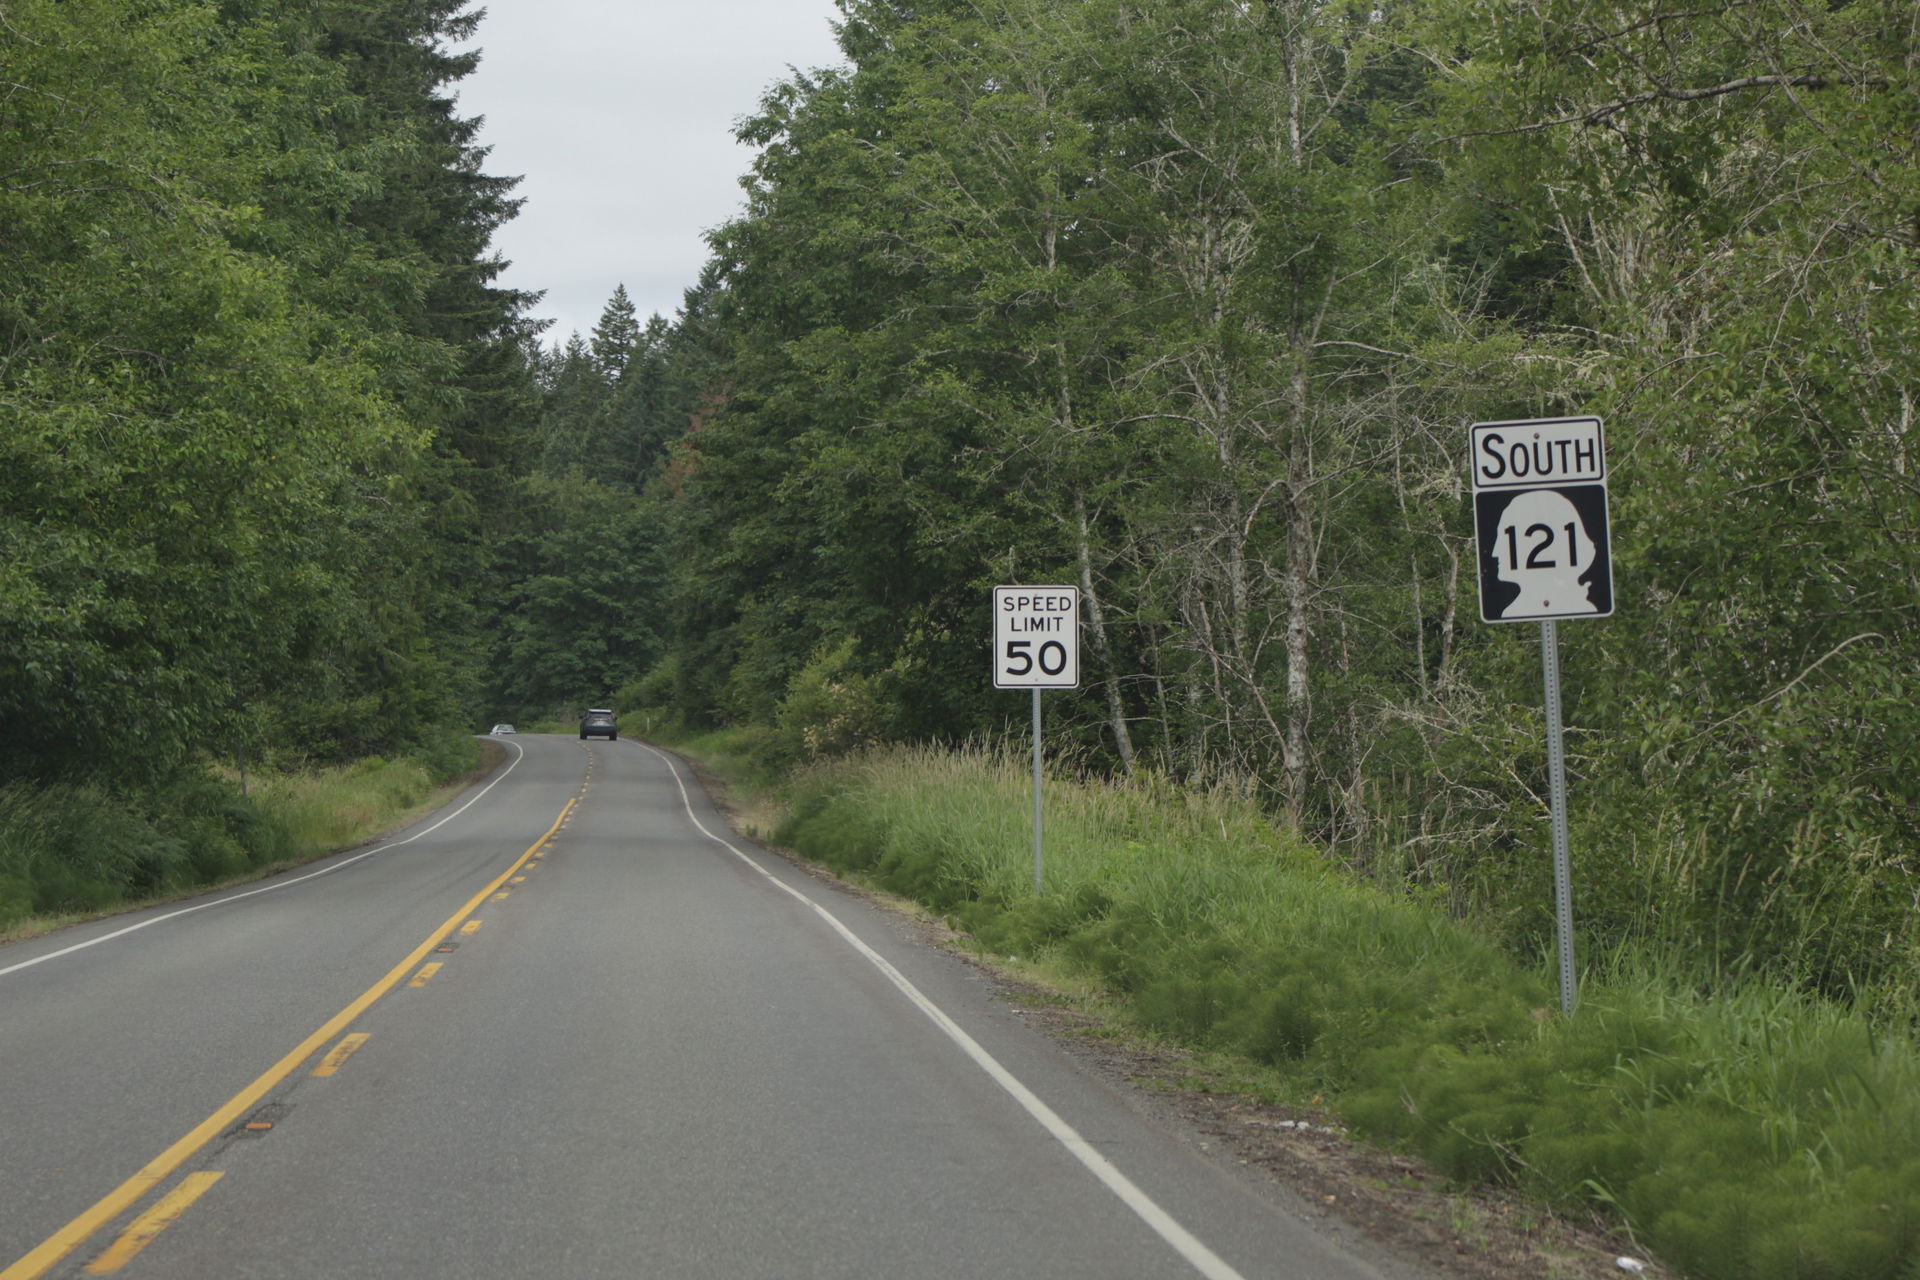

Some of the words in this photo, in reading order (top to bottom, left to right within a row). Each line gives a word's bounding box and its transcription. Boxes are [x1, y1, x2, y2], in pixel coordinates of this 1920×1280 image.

[1481, 433, 1596, 479] SOUTH
[1504, 521, 1578, 571] 121
[1003, 596, 1072, 612] SPEED
[1010, 616, 1064, 632] LIMIT
[1005, 640, 1067, 676] 50
